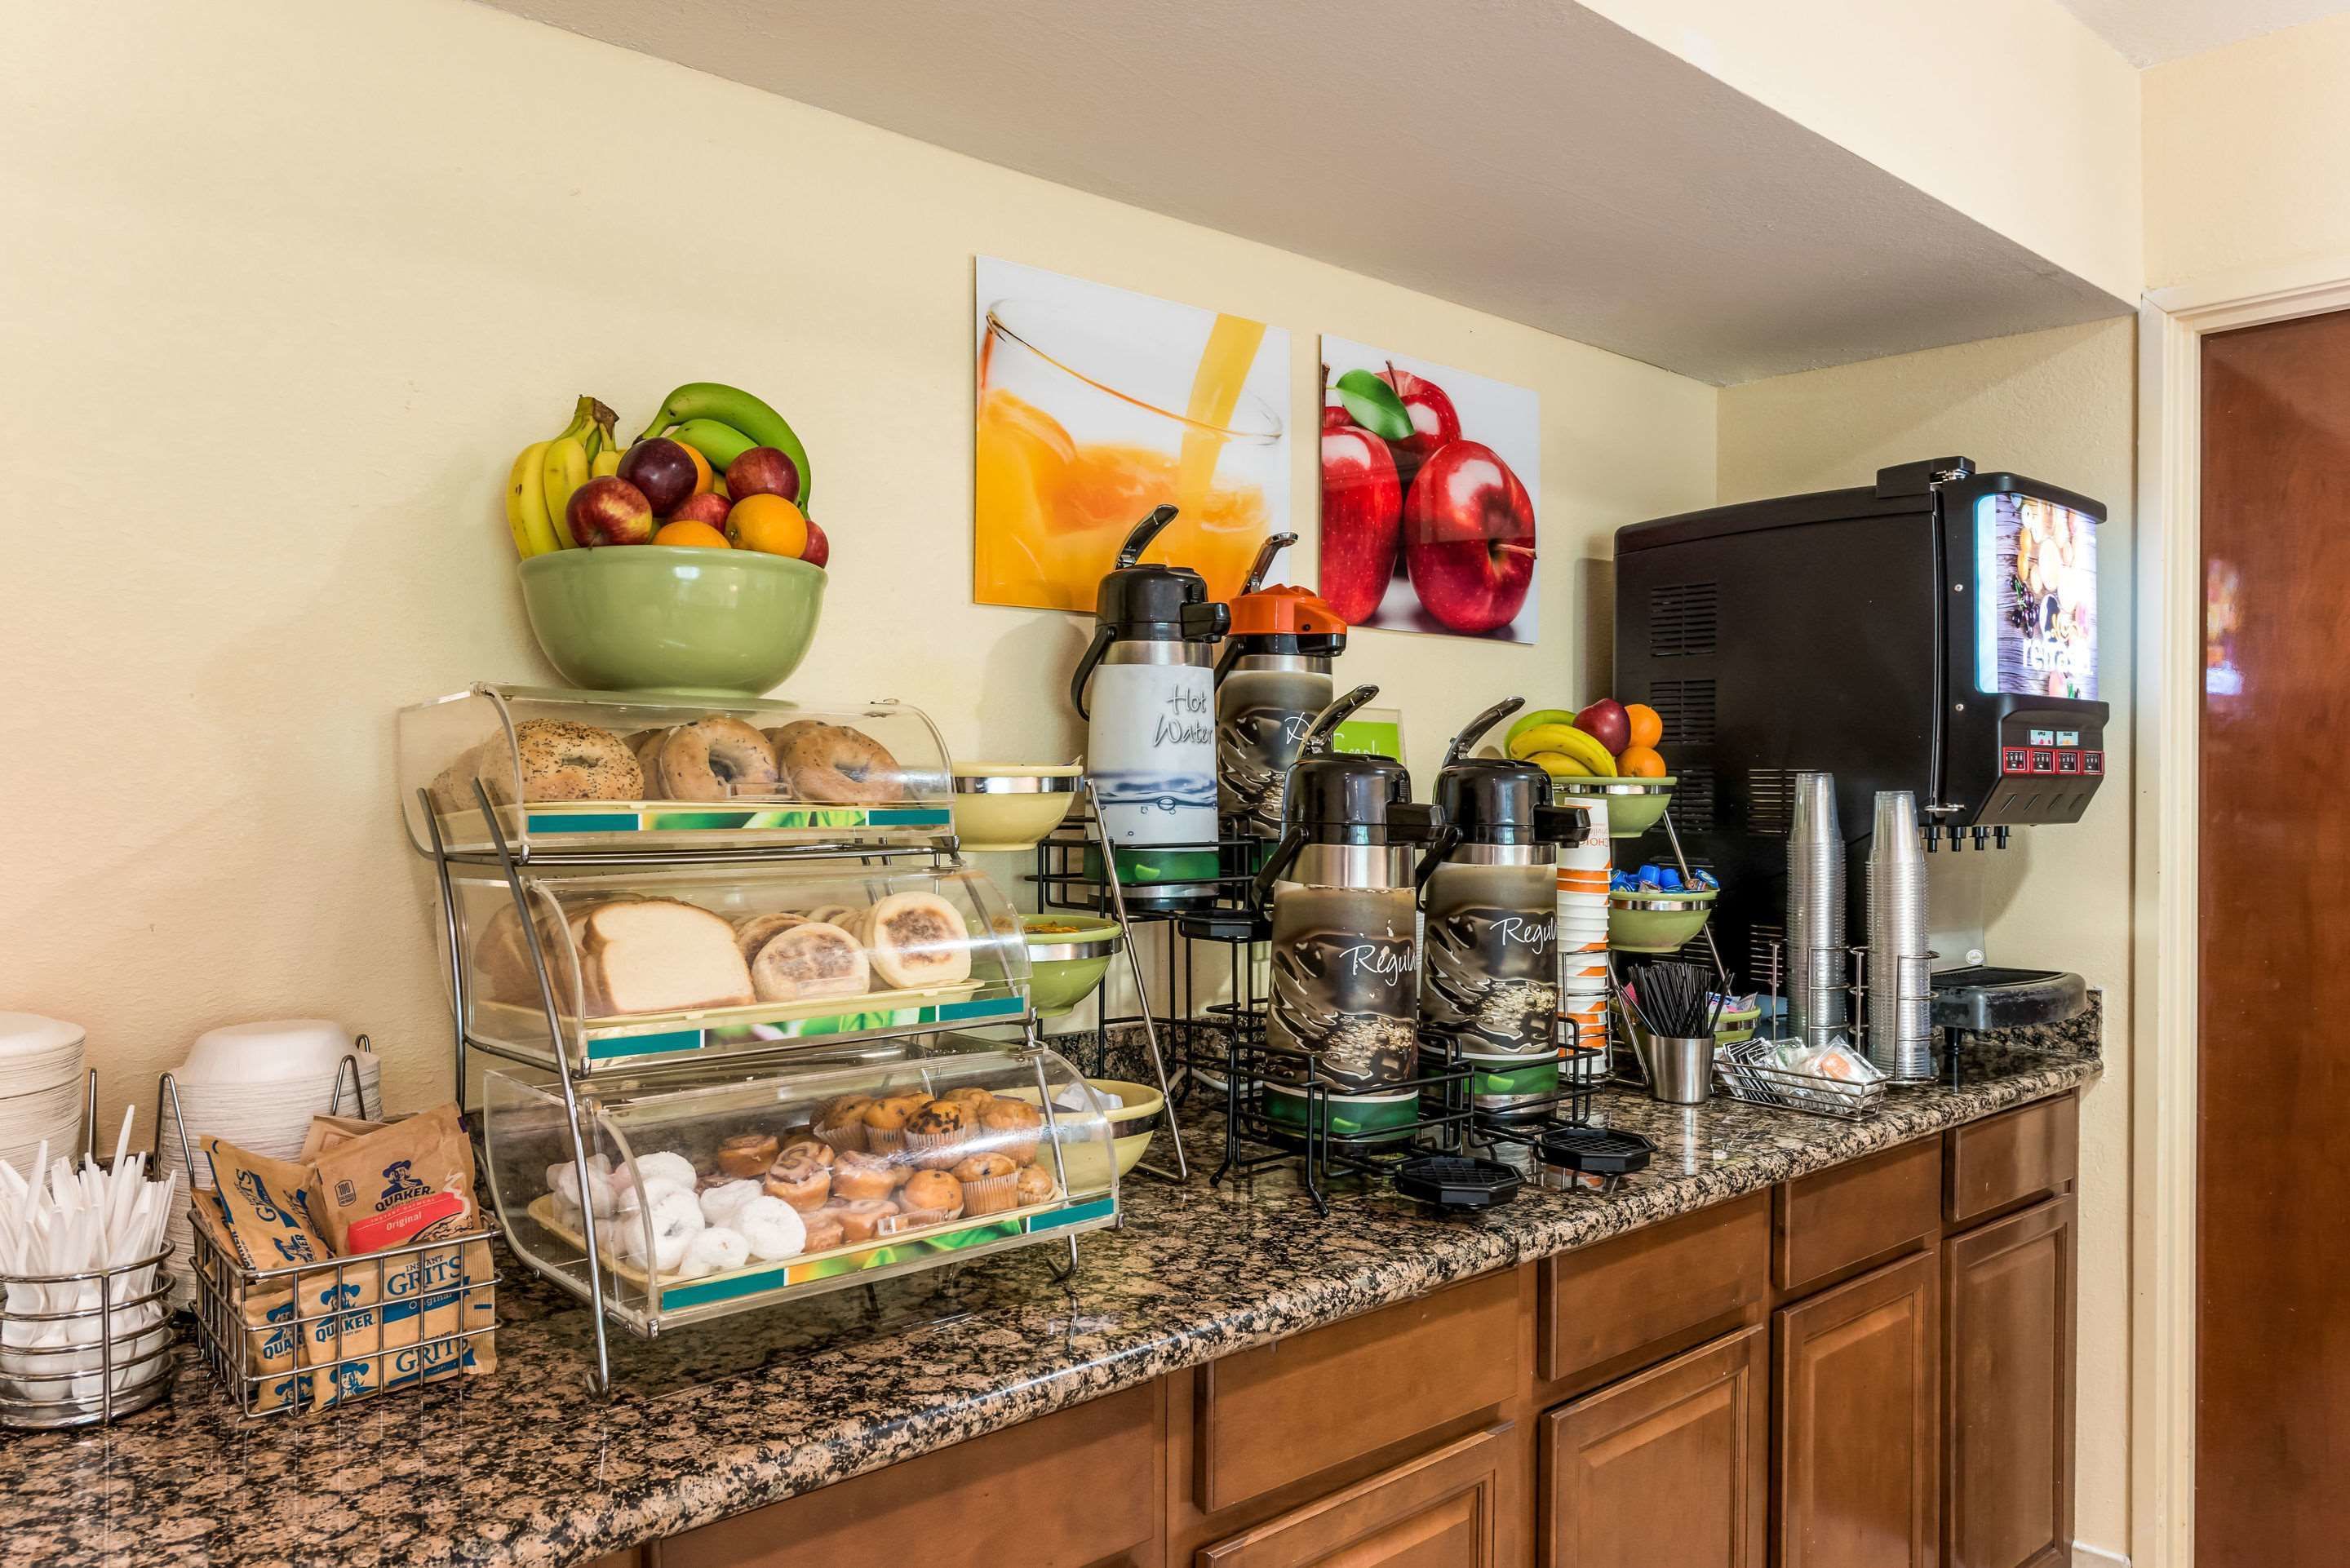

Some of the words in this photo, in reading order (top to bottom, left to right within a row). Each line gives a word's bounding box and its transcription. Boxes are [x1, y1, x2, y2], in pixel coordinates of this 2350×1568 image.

[1167, 685, 1206, 715] Hot
[1154, 714, 1213, 747] Water
[1489, 916, 1558, 955] Regul
[375, 1185, 432, 1212] QUAKER
[386, 1211, 422, 1231] Original
[387, 1256, 463, 1296] GRITS
[406, 1255, 444, 1272] INSANT
[315, 1313, 373, 1343] QUKER
